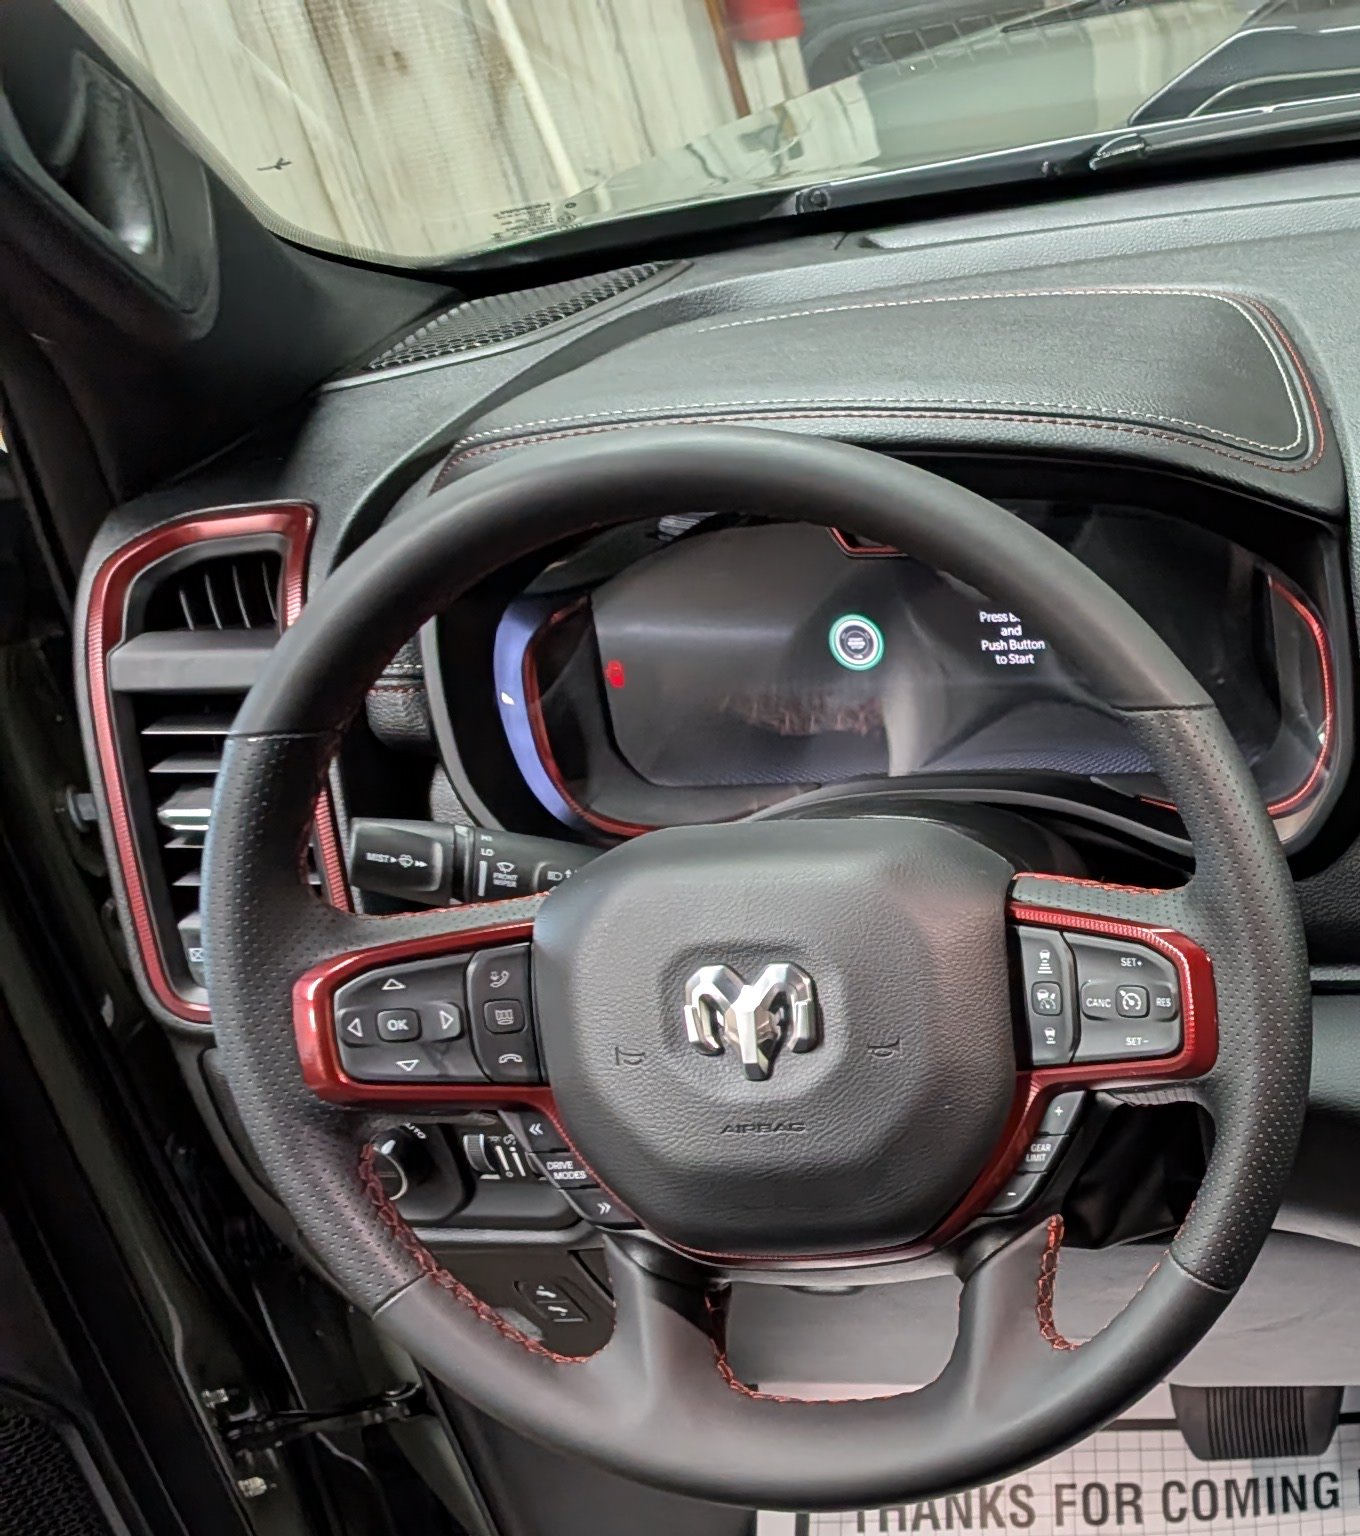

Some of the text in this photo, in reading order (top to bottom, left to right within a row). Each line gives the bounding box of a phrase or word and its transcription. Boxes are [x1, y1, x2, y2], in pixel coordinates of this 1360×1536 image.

[979, 611, 1008, 623] Press
[1000, 624, 1022, 636] and
[981, 639, 1046, 651] Push Button
[995, 653, 1035, 665] to Start
[366, 852, 390, 864] MIST
[480, 848, 495, 857] LO
[1085, 998, 1112, 1009] CANC
[1156, 997, 1172, 1008] RES
[386, 1020, 410, 1032] OK
[719, 1122, 807, 1134] AIRBAG
[1030, 1143, 1052, 1153] GEAR
[1025, 1153, 1047, 1163] LIMIT
[546, 1161, 574, 1170] DRIVE
[553, 1170, 588, 1180] MODES
[1055, 1482, 1143, 1527] FOR
[1161, 1471, 1340, 1524] COMING
